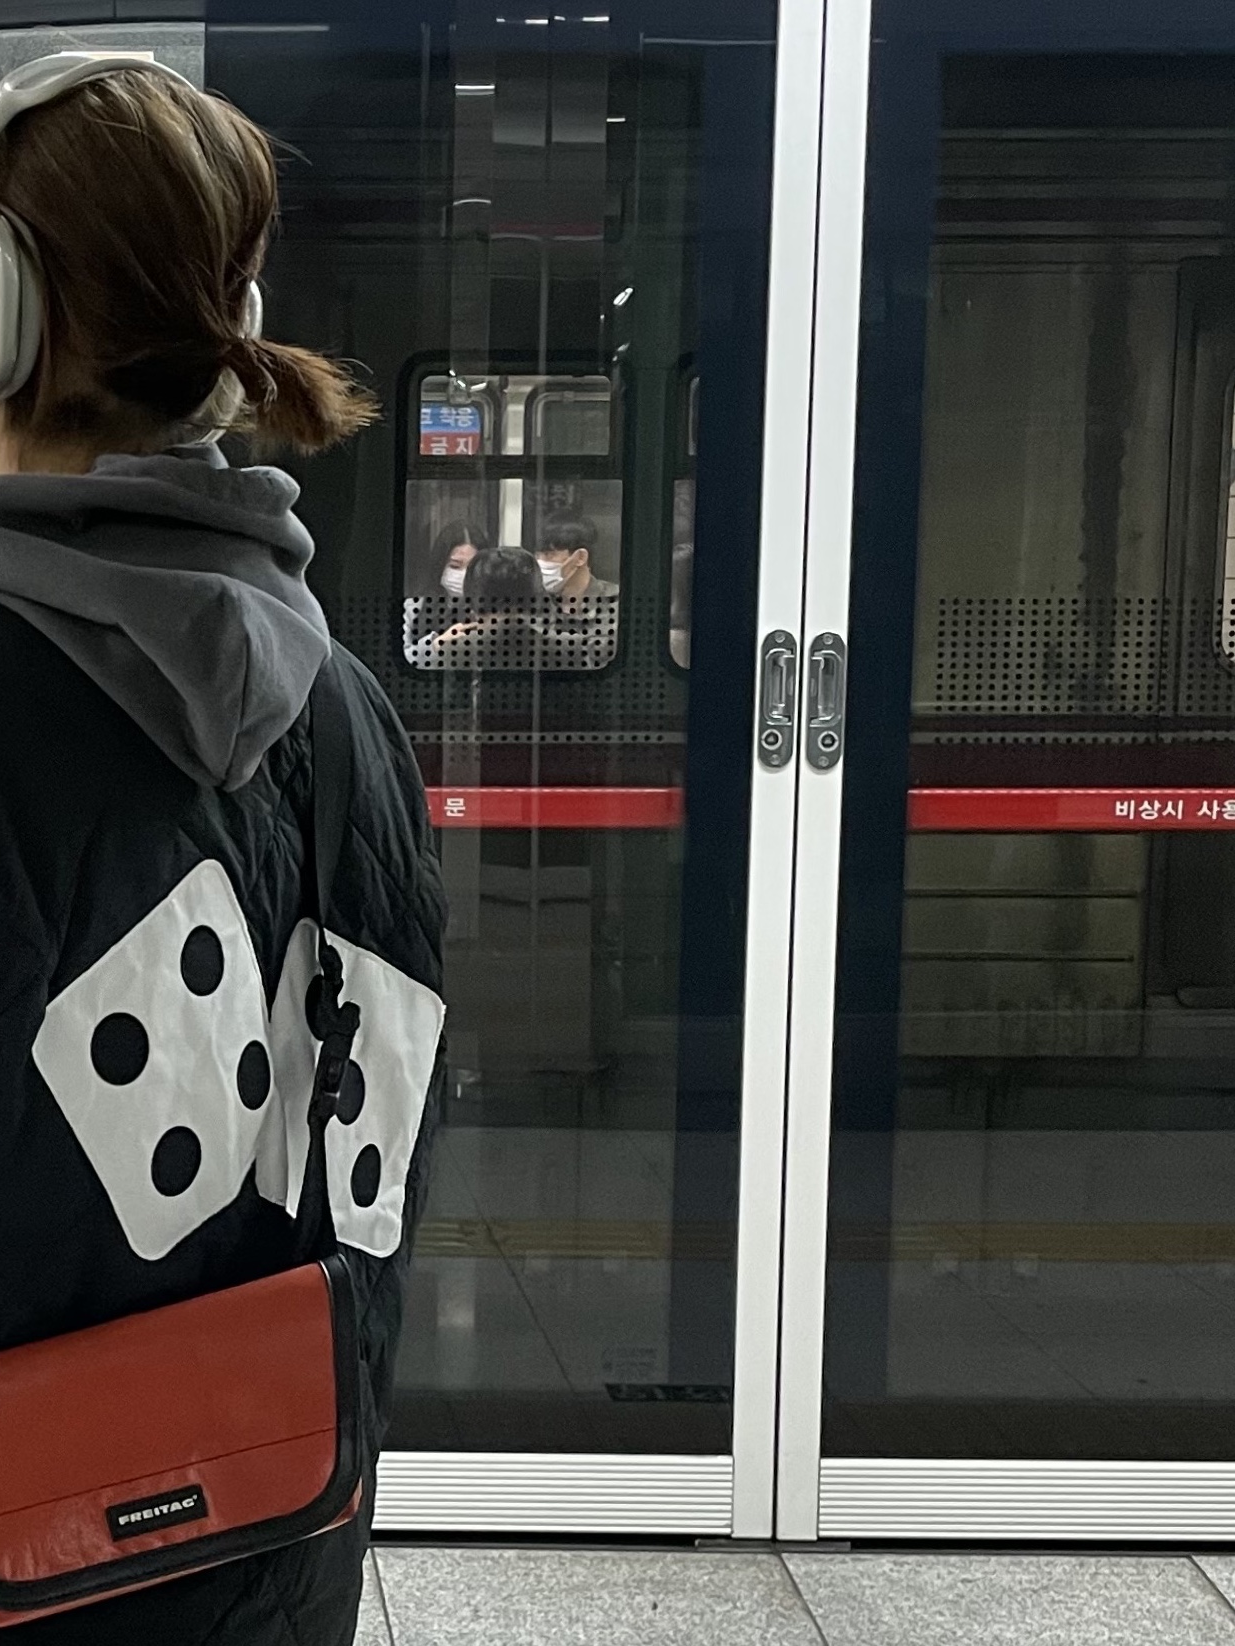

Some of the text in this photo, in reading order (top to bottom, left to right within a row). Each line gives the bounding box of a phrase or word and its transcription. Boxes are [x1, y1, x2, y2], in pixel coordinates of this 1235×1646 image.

[444, 798, 466, 817] 문
[1115, 800, 1184, 820] 비상시
[118, 1496, 196, 1525] FREITAG
